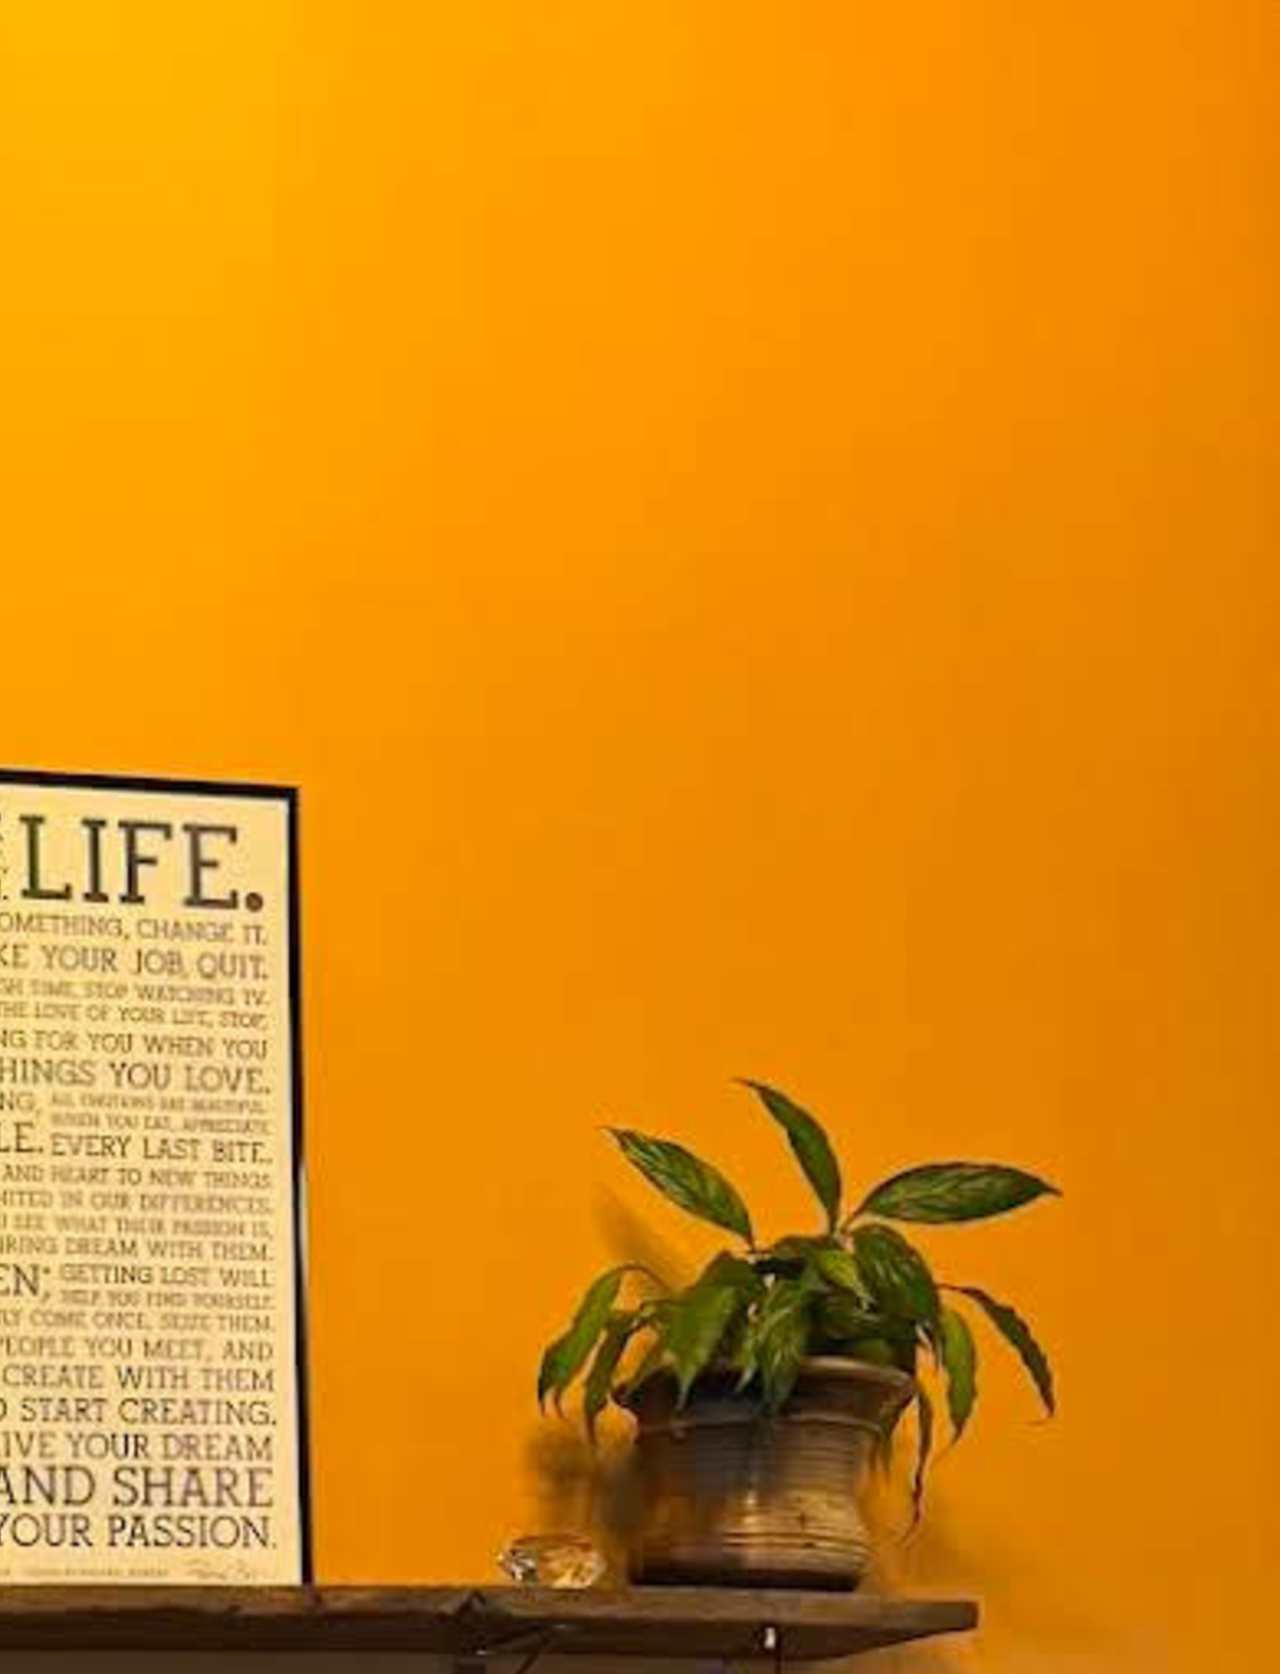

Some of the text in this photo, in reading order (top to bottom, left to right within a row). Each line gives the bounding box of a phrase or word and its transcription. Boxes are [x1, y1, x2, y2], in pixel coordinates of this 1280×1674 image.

[19, 814, 264, 912] LIFE.
[137, 918, 233, 943] CHANGE
[41, 945, 118, 973] YOUR
[197, 952, 268, 980] QUIT.
[33, 1030, 79, 1051] FOR
[90, 1033, 133, 1053] YOU
[142, 1035, 213, 1055] WHEN
[222, 1038, 268, 1059] YOU
[109, 1061, 172, 1089] YOU
[185, 1065, 271, 1095] LOVE.
[50, 1133, 131, 1157] EVERY
[142, 1138, 202, 1161] LAST
[4, 1164, 44, 1183] AND
[117, 1169, 142, 1185] TO
[59, 1263, 273, 1287] GETTING LOST WILL
[84, 1338, 132, 1358] YOU
[222, 1340, 273, 1361] AND
[2, 1365, 104, 1389] CREATE
[115, 1366, 187, 1391] WITH
[200, 1368, 274, 1392] THEM
[21, 1398, 109, 1423] START
[118, 1399, 277, 1426] CREATING.
[66, 1433, 149, 1459] YOUR
[162, 1434, 272, 1461] DREAM
[112, 1466, 274, 1508] SHARE
[107, 1515, 277, 1549] PASSION.
